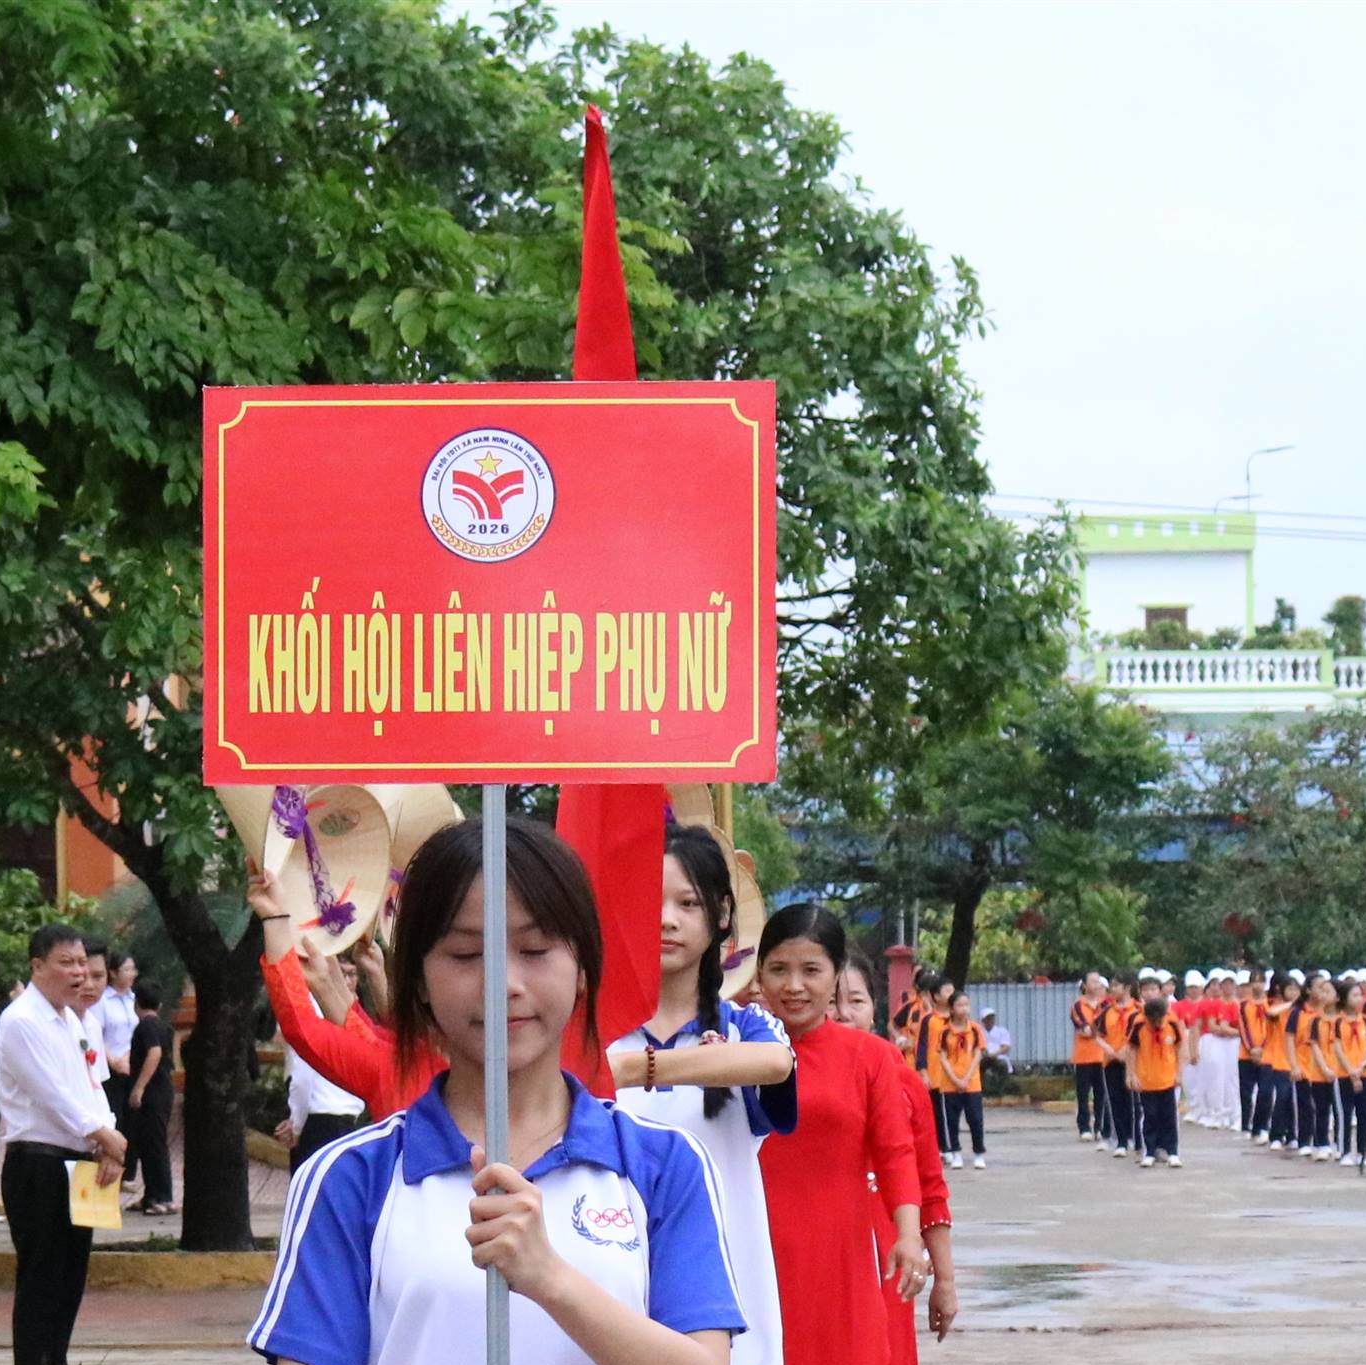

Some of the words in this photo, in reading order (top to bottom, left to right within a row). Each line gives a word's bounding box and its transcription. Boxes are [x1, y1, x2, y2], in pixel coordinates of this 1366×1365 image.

[473, 436, 490, 444] NAM
[492, 436, 509, 445] NINH
[468, 524, 510, 535] 2026
[249, 576, 331, 714] KHỐI
[343, 591, 401, 737] HỘI
[413, 590, 492, 712] LIÊN
[503, 590, 584, 736] HIỆP
[595, 611, 667, 736] PHỤ
[678, 590, 733, 713] NỮ
